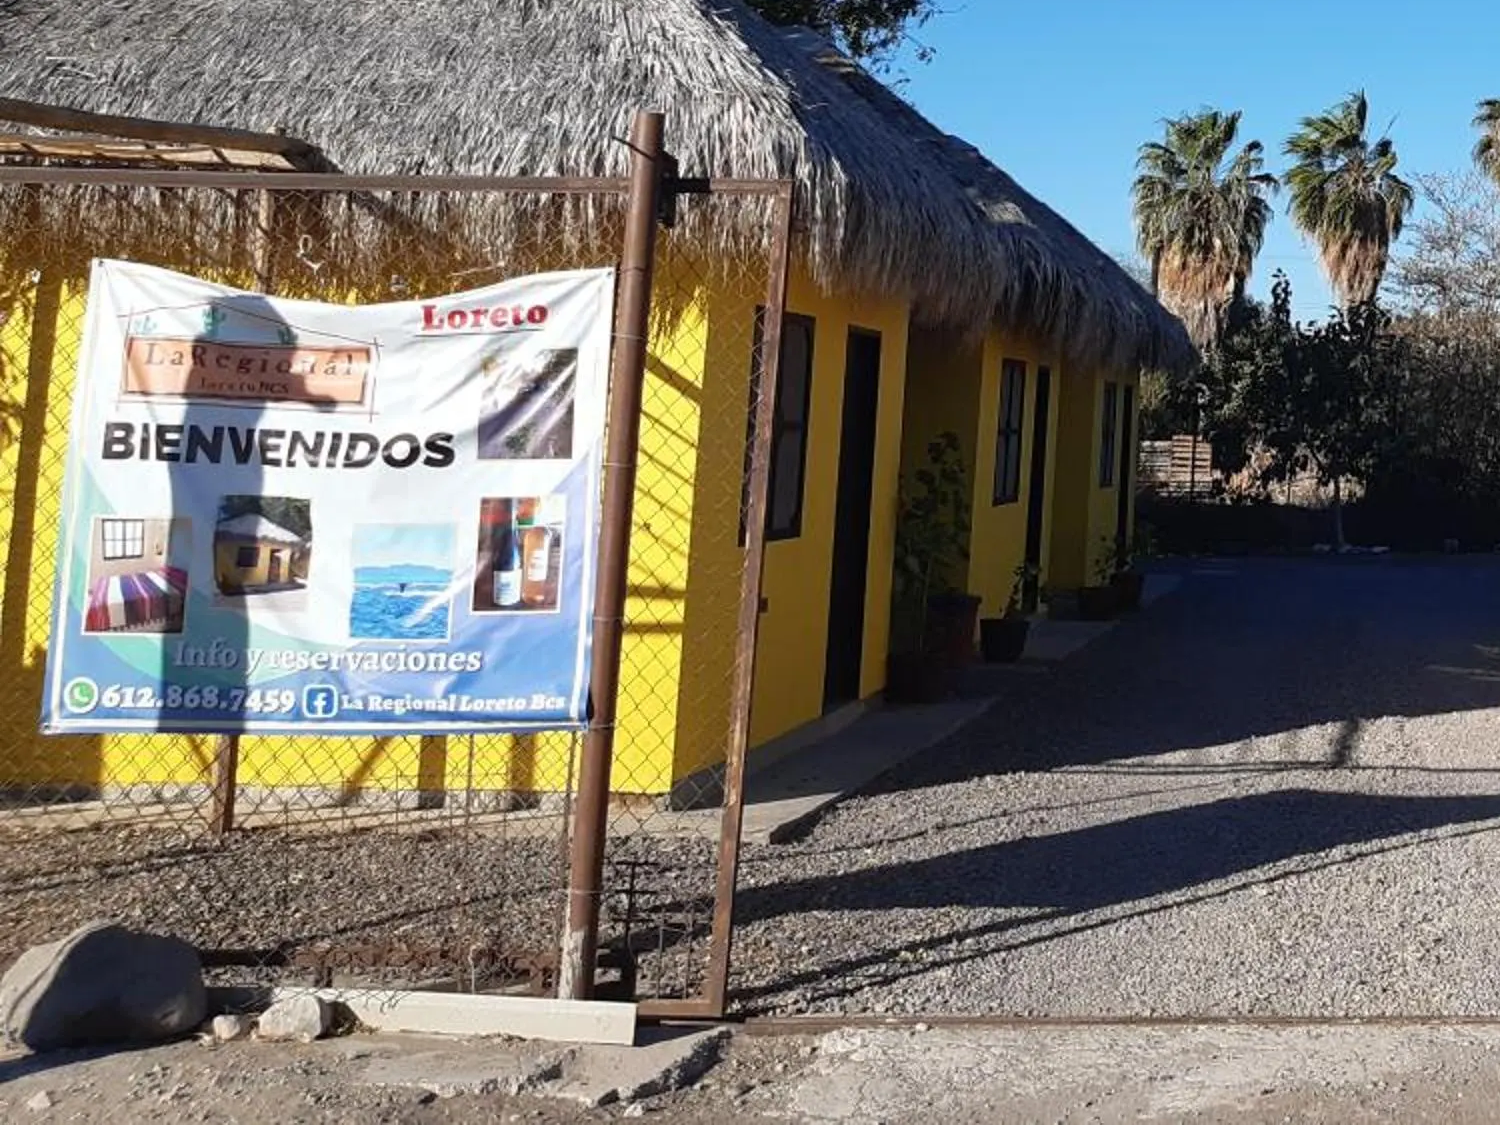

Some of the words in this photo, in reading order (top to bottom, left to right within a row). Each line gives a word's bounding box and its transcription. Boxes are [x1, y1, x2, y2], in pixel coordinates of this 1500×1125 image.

[421, 304, 549, 331] Loreto
[101, 422, 456, 469] BIENVENIDOS
[174, 638, 239, 668] Info
[246, 648, 265, 674] y
[269, 644, 483, 672] reservaciones
[101, 683, 296, 712] 612.868.7459
[341, 694, 364, 711] La
[367, 694, 455, 715] Regional
[456, 694, 528, 712] Loreto
[530, 693, 566, 710] Bcs
